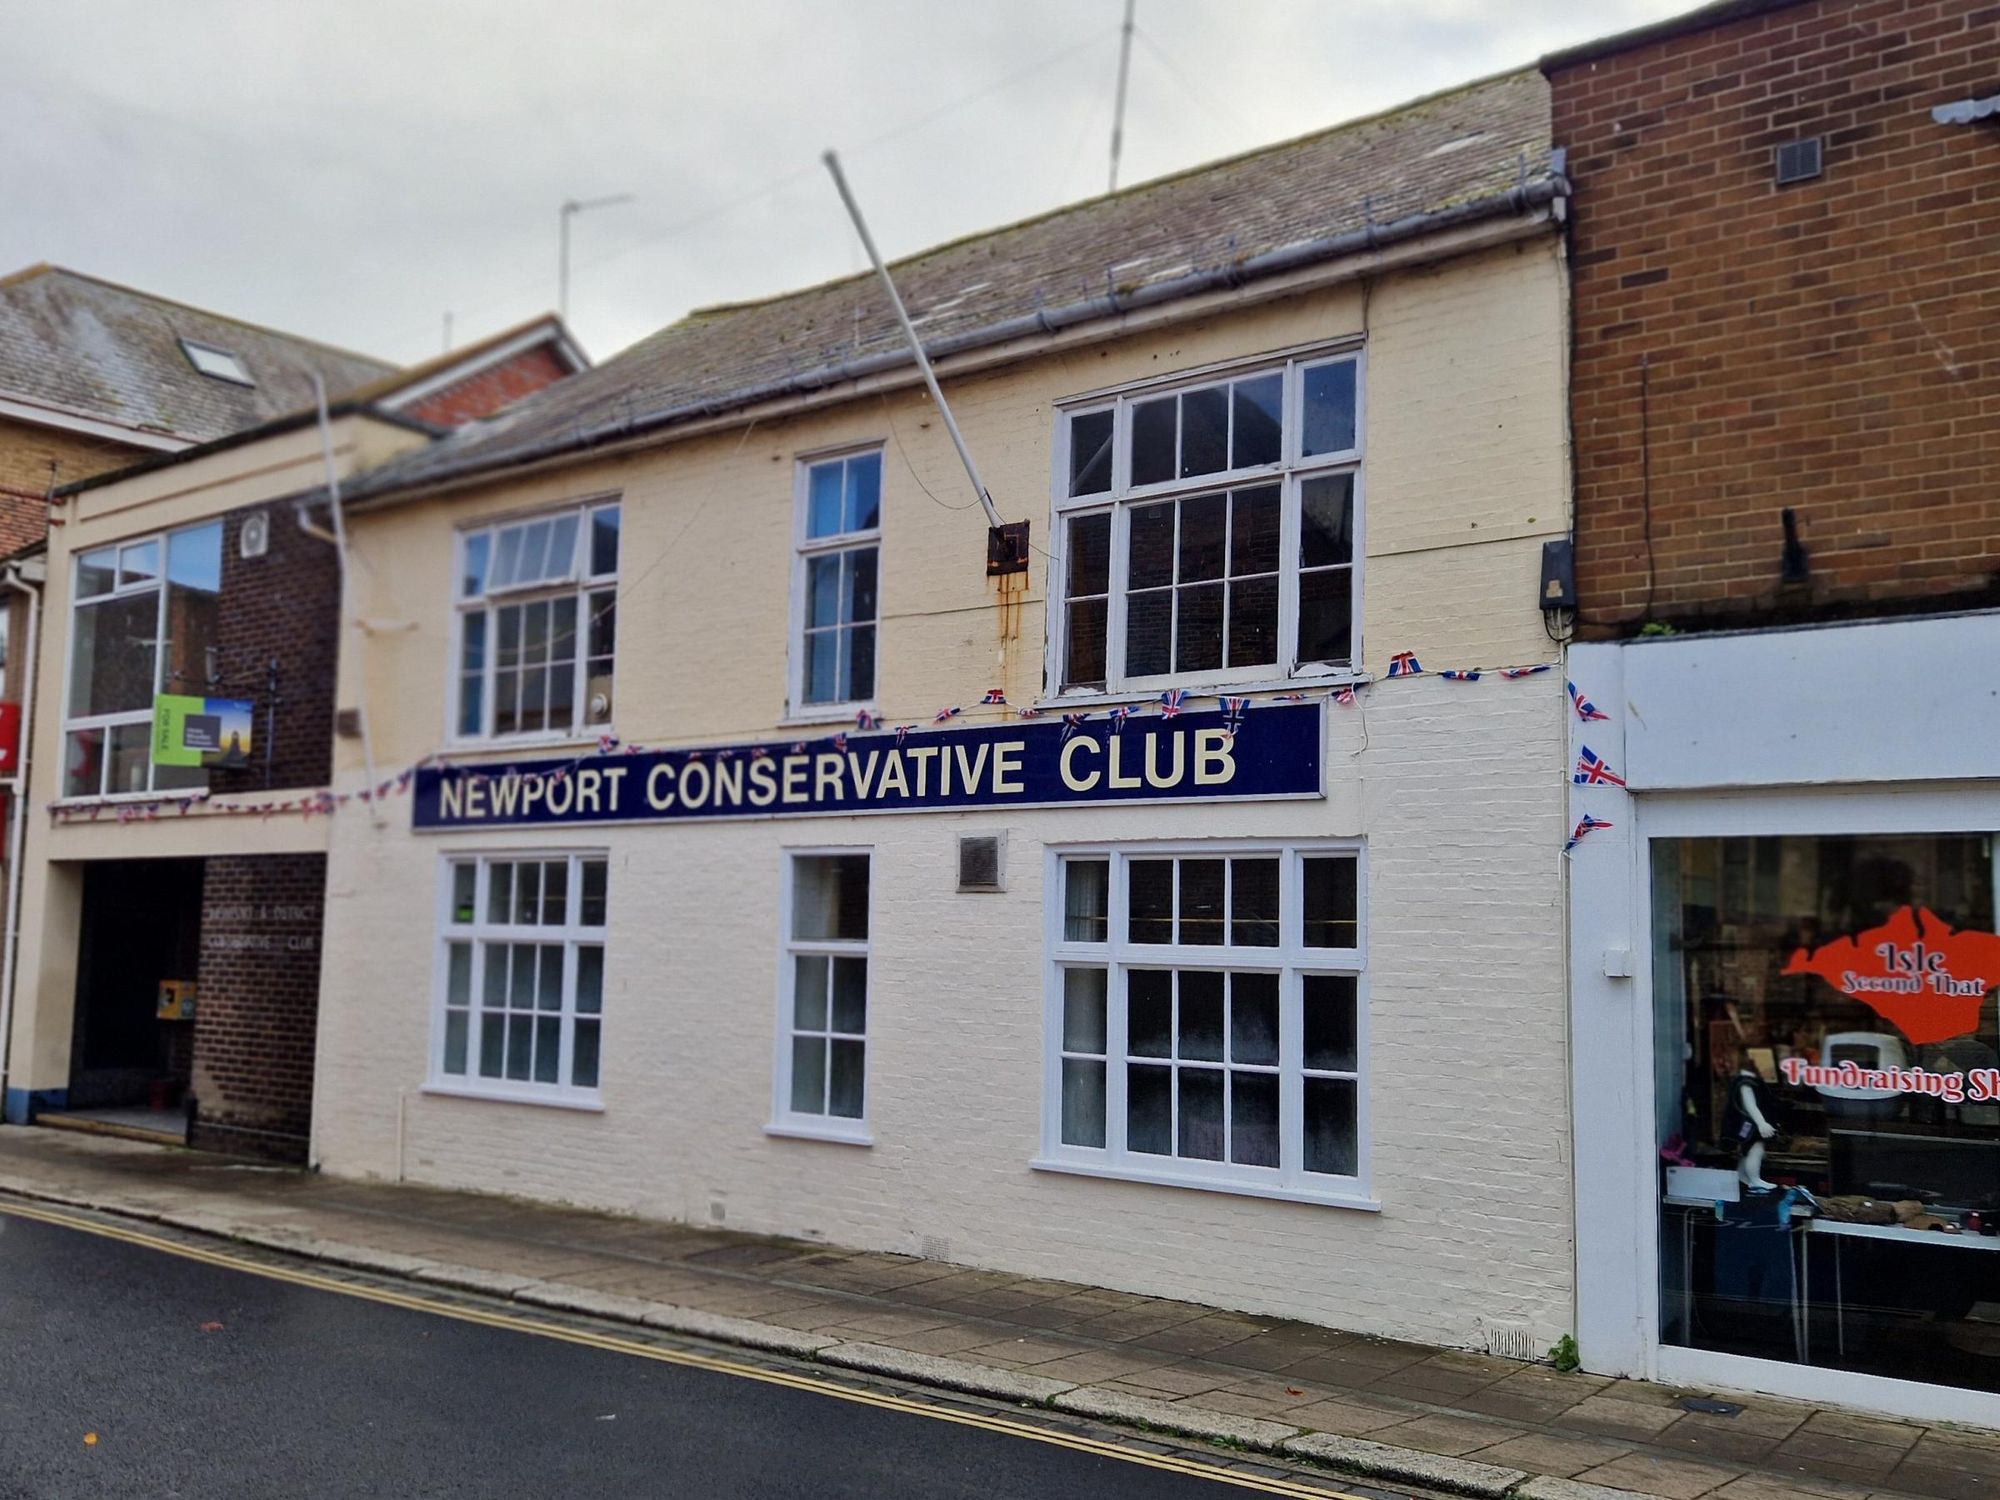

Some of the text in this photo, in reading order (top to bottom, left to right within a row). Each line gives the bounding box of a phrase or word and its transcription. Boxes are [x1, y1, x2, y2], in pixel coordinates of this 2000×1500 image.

[440, 728, 1236, 818] NEWPORT CONSERVATIVE CLUB
[1876, 942, 1948, 974] Isle
[1842, 973, 1985, 997] Second That
[1780, 1057, 1965, 1102] Fundraising
